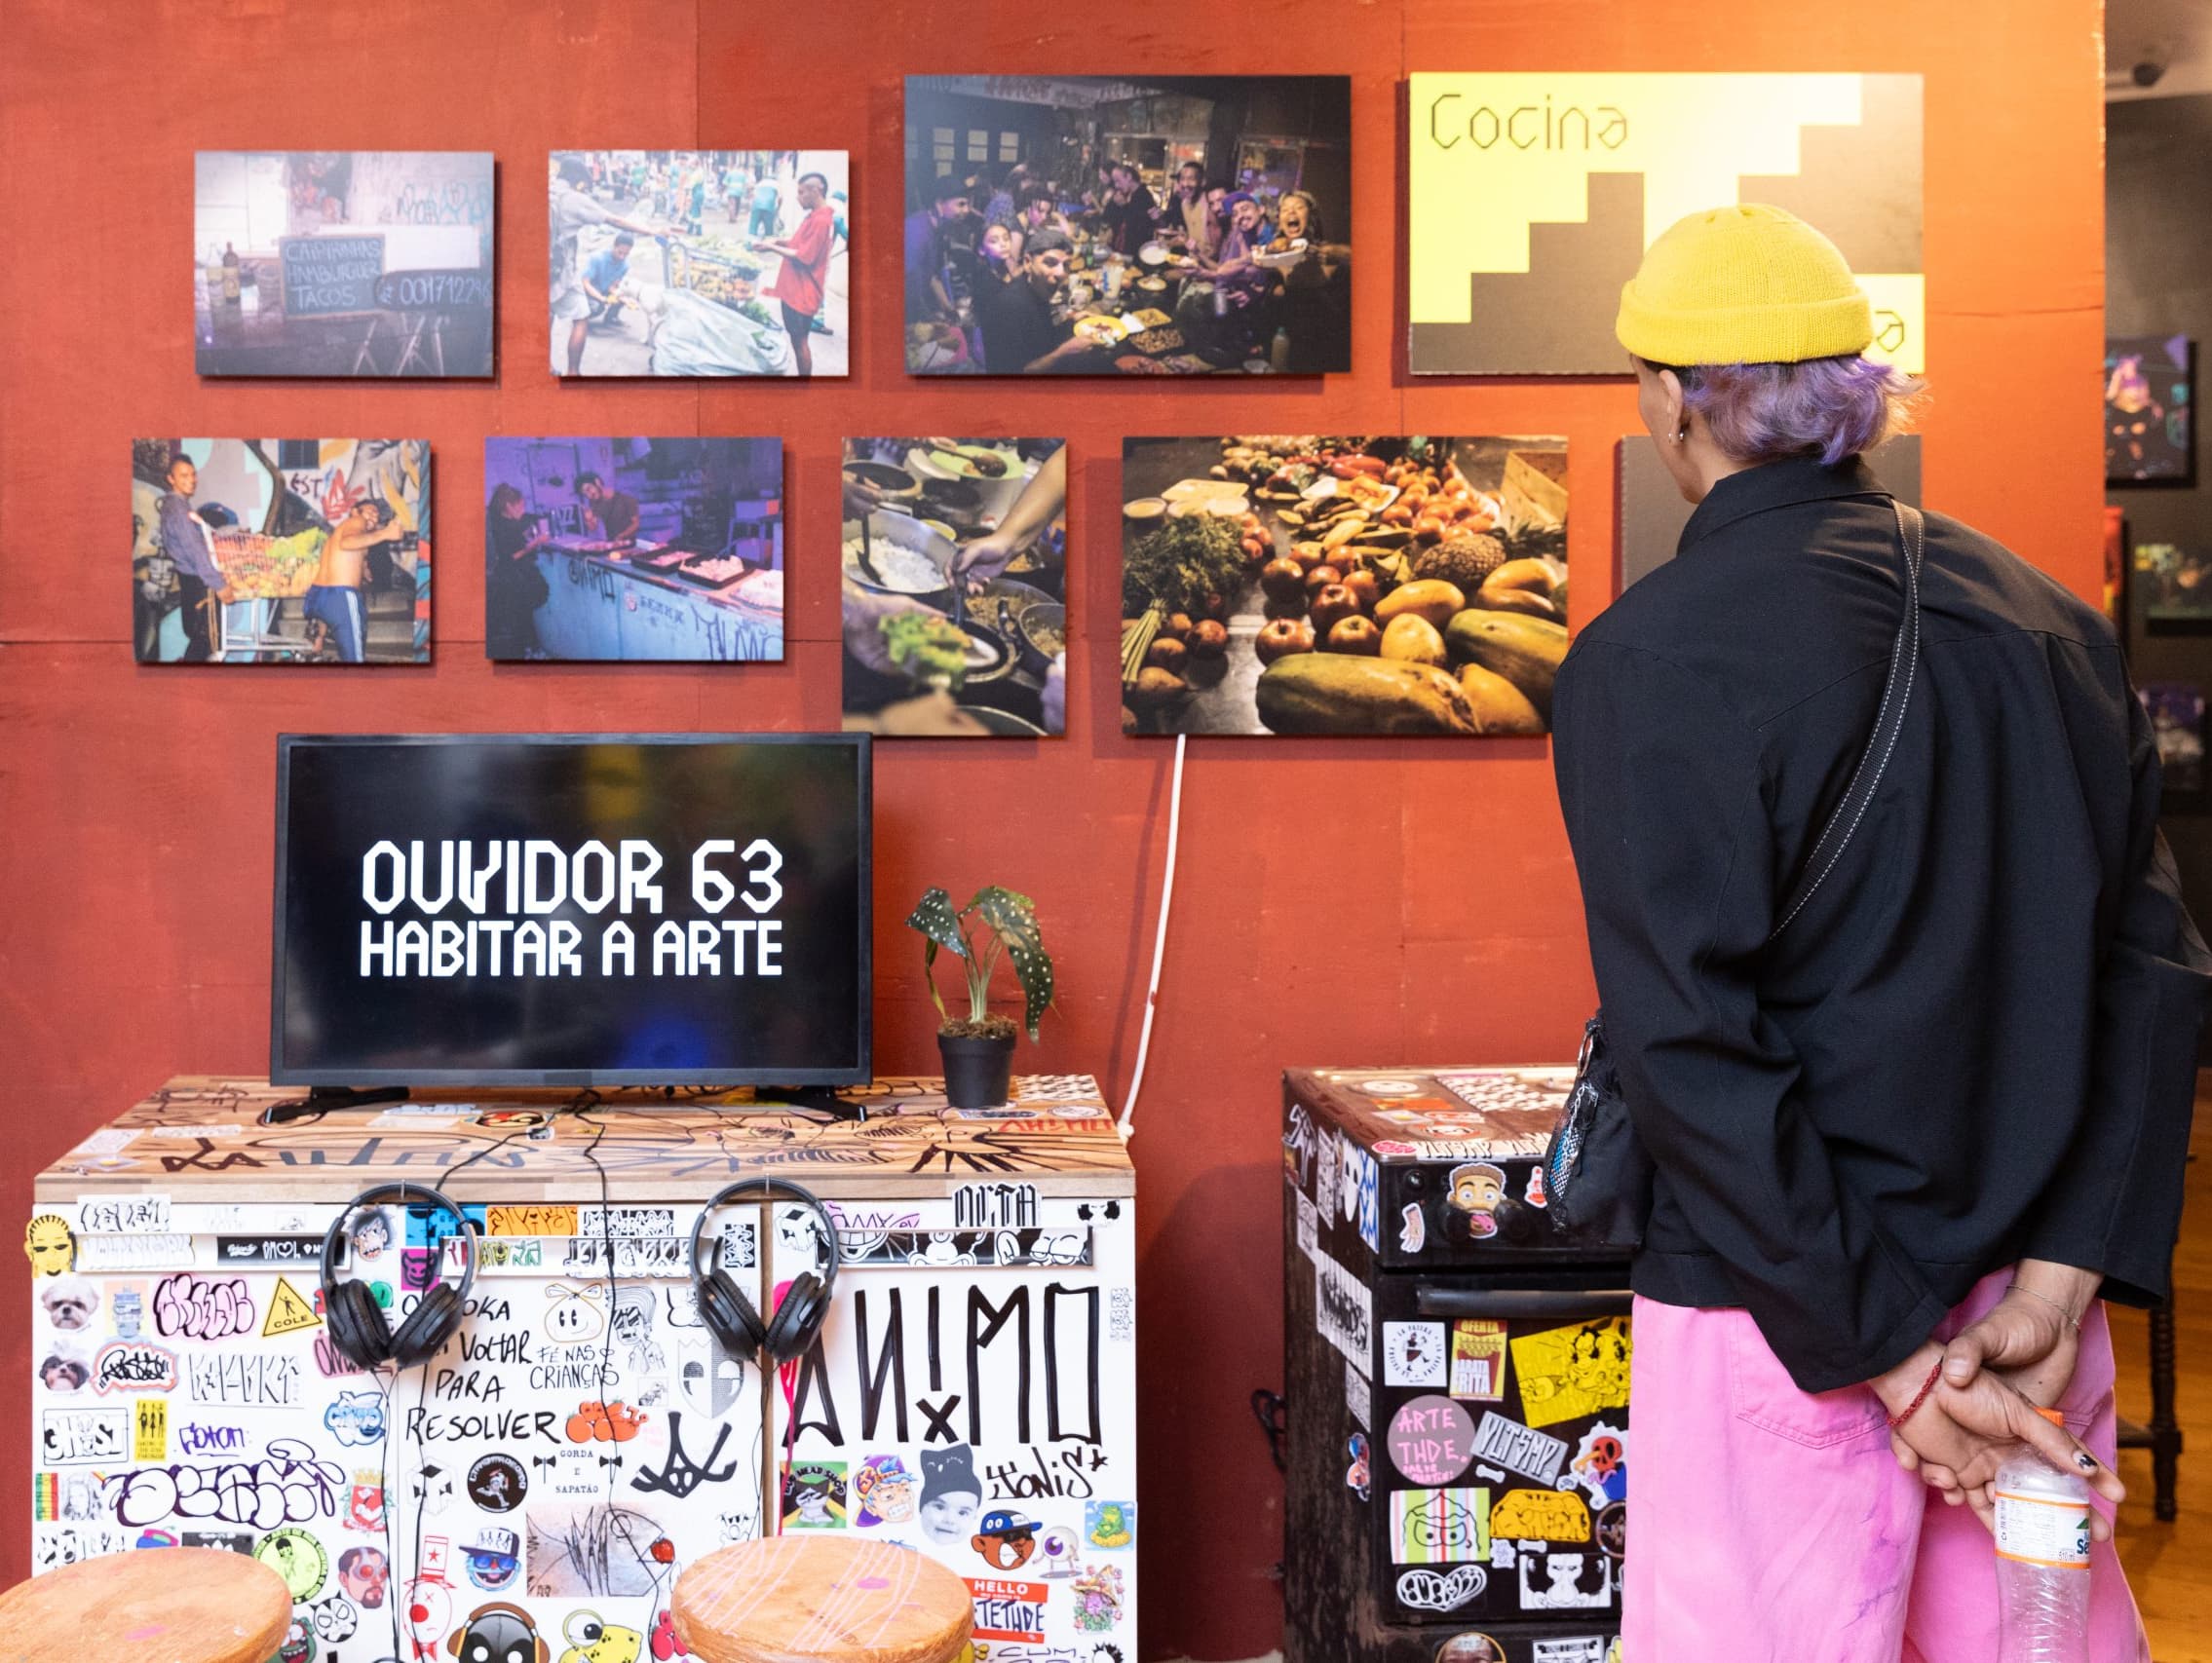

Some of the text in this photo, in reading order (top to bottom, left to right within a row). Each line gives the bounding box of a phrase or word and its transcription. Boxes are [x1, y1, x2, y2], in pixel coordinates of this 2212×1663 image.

[1431, 94, 1628, 150] Cocina
[290, 284, 357, 310] TACOS
[362, 839, 783, 915] OUVIDOR 63
[361, 921, 782, 976] HABITAR A ARTE
[274, 1314, 309, 1330] COLE
[565, 1344, 595, 1363] NAS
[435, 1369, 506, 1403] PARA
[405, 1407, 561, 1445] RESOLVER
[559, 1450, 594, 1458] GORDA
[554, 1485, 599, 1493] SAPATÃO
[973, 1579, 1029, 1595] HELLO
